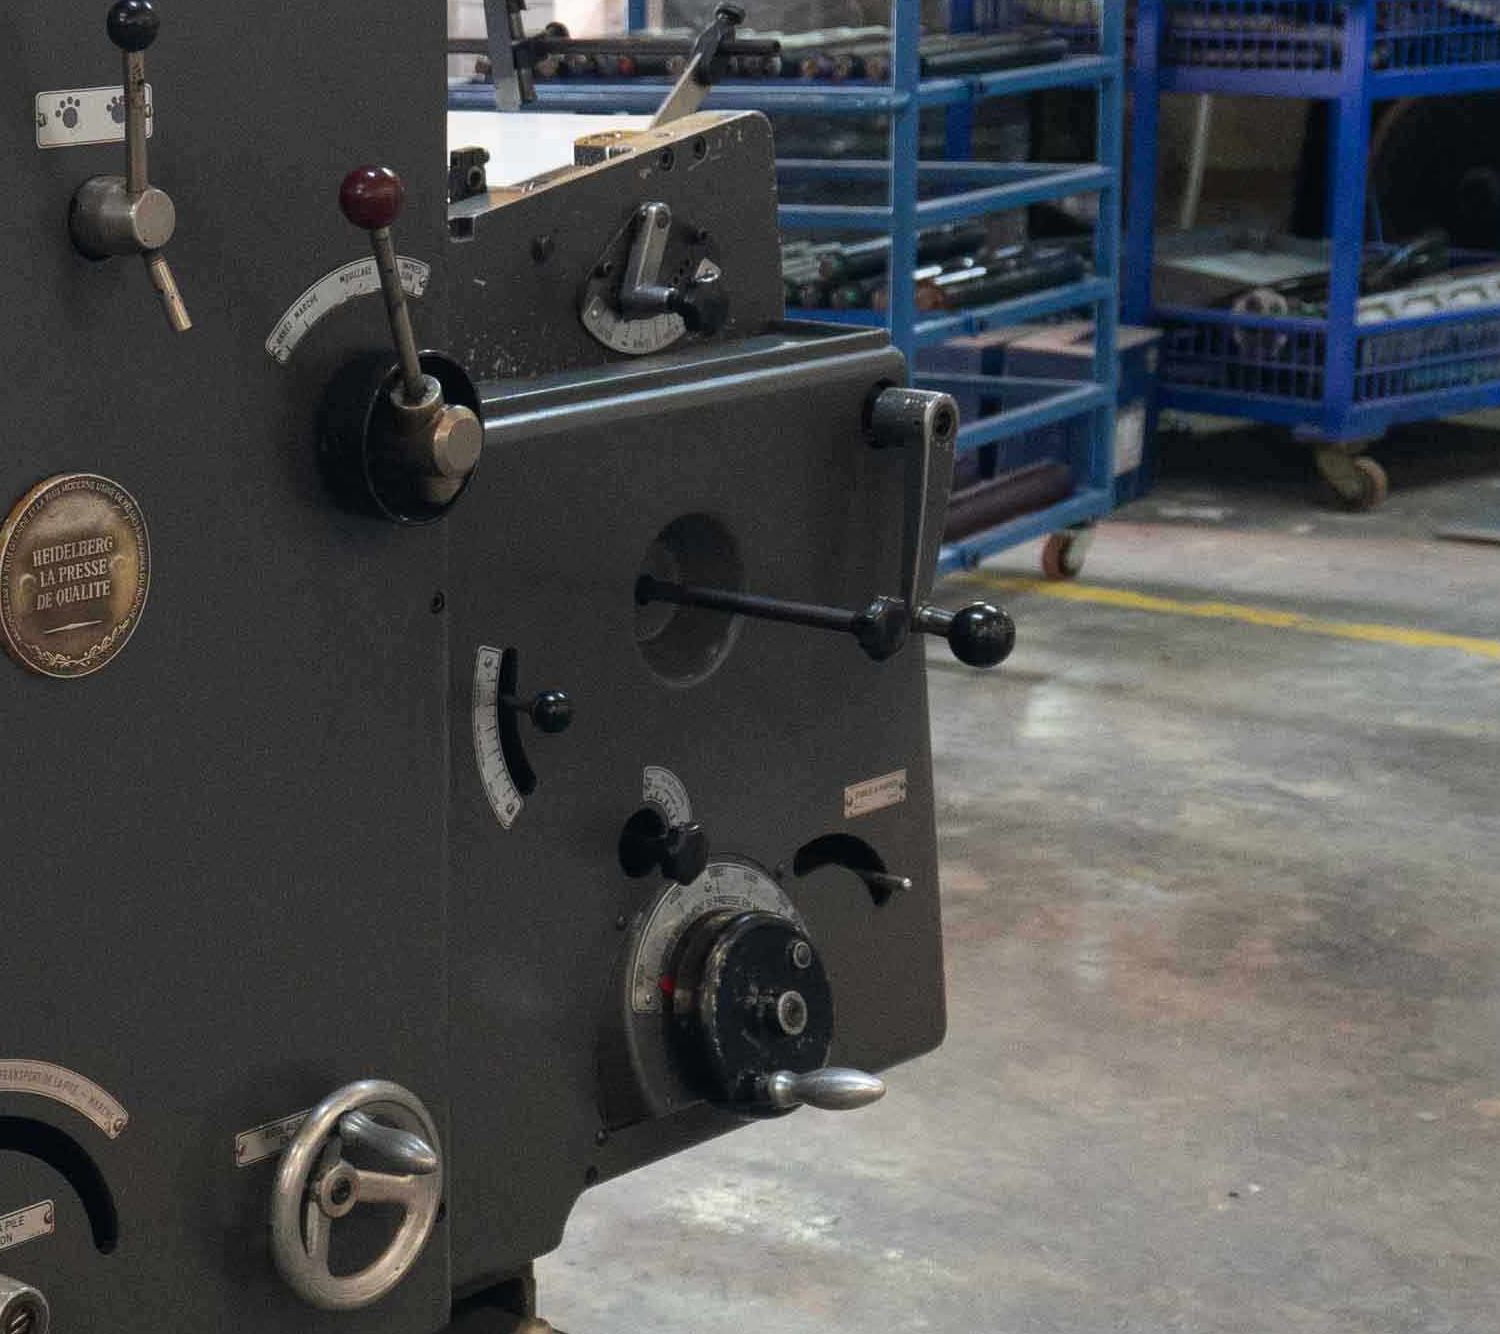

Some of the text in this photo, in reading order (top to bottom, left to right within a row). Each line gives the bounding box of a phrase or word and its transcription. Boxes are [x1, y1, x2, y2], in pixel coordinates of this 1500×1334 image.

[32, 536, 114, 567] HEIDELBERG
[39, 559, 108, 588] LA PRESSE
[36, 593, 53, 611] DE
[4, 1215, 26, 1231] PILE
